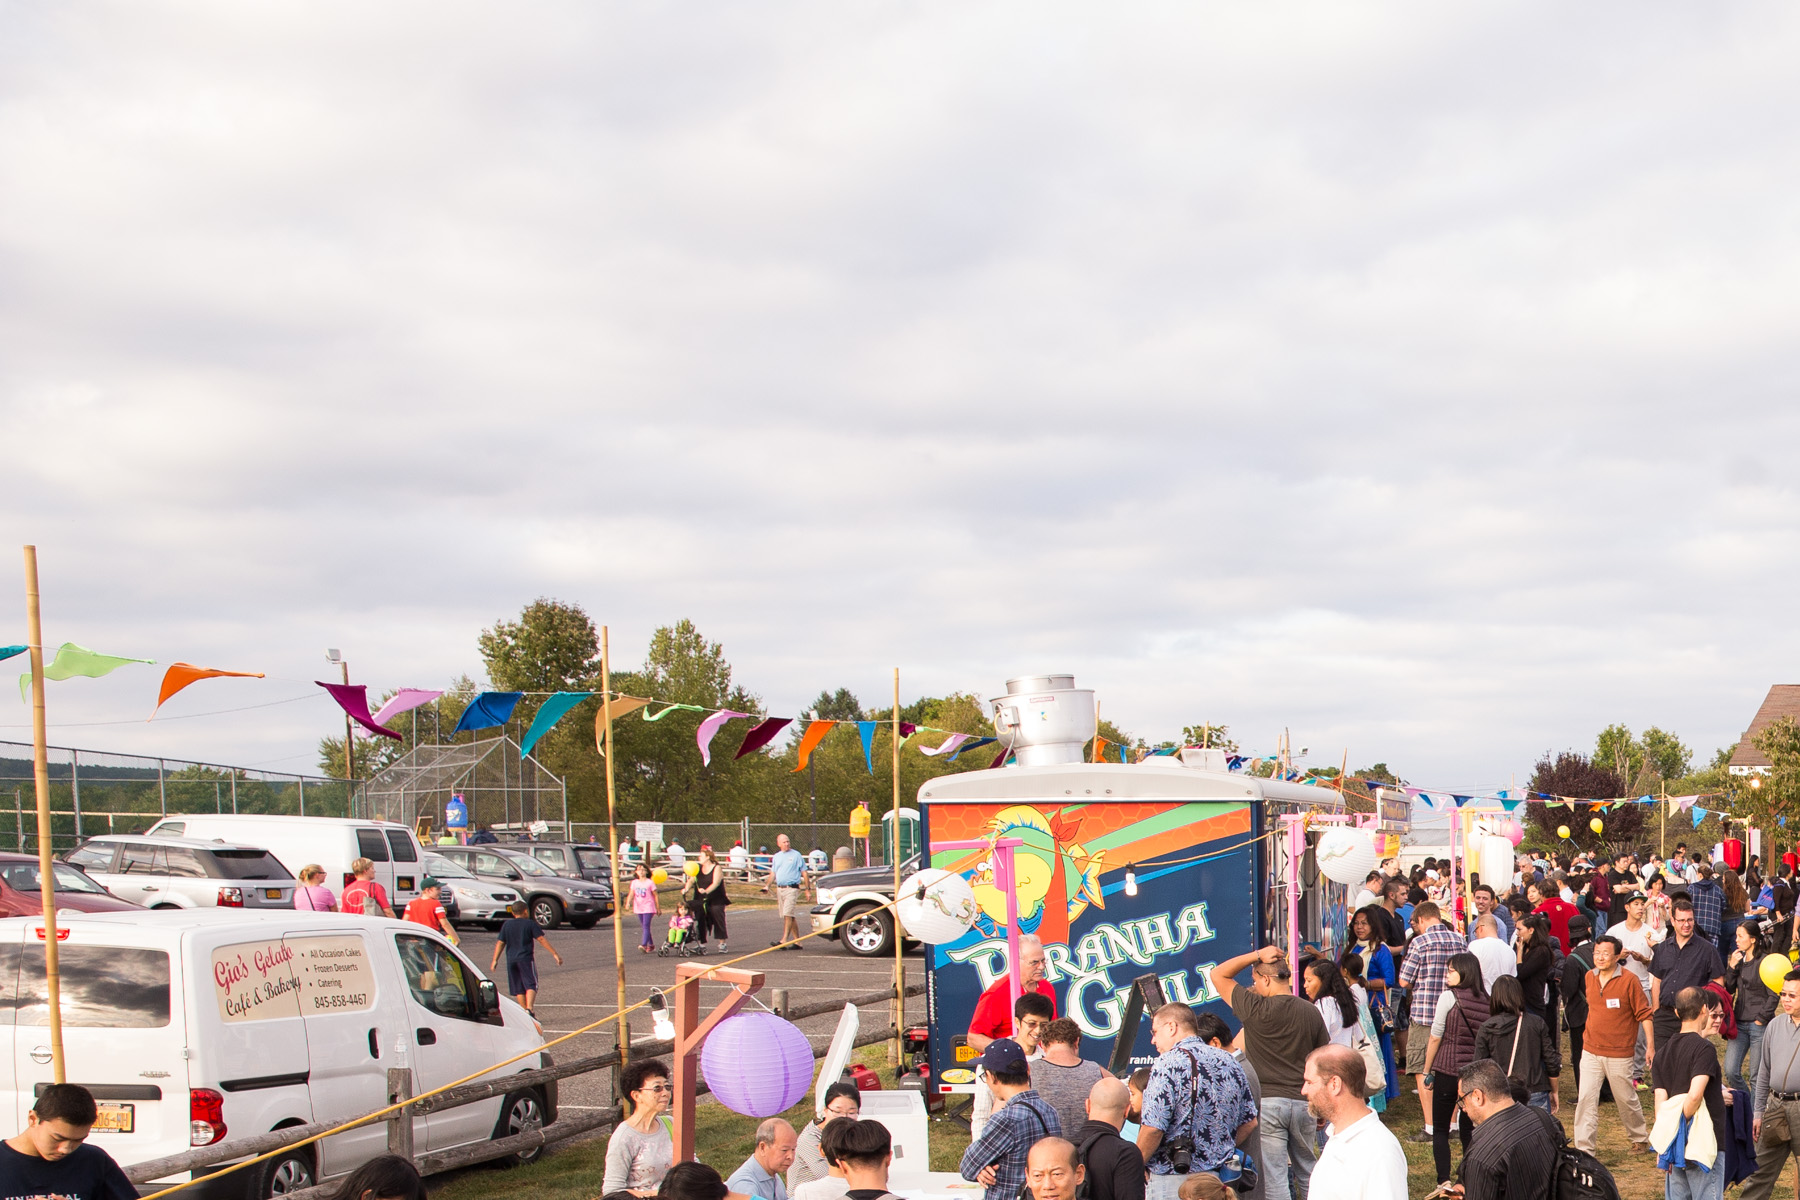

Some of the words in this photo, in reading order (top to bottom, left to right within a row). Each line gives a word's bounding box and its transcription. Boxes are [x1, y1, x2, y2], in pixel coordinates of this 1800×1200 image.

[310, 950, 318, 959] All
[319, 949, 345, 958] Occasion
[345, 948, 362, 957] Cakes
[946, 901, 1217, 993] PRANHA
[214, 954, 249, 995] Gio's
[254, 945, 295, 978] Gelato
[314, 964, 334, 973] Frozen
[334, 963, 359, 972] Desserts
[317, 978, 343, 989] Catering
[225, 993, 252, 1016] Café
[254, 987, 263, 1005] &
[264, 975, 302, 1000] Bakery
[314, 993, 367, 1009] 845-858-4467
